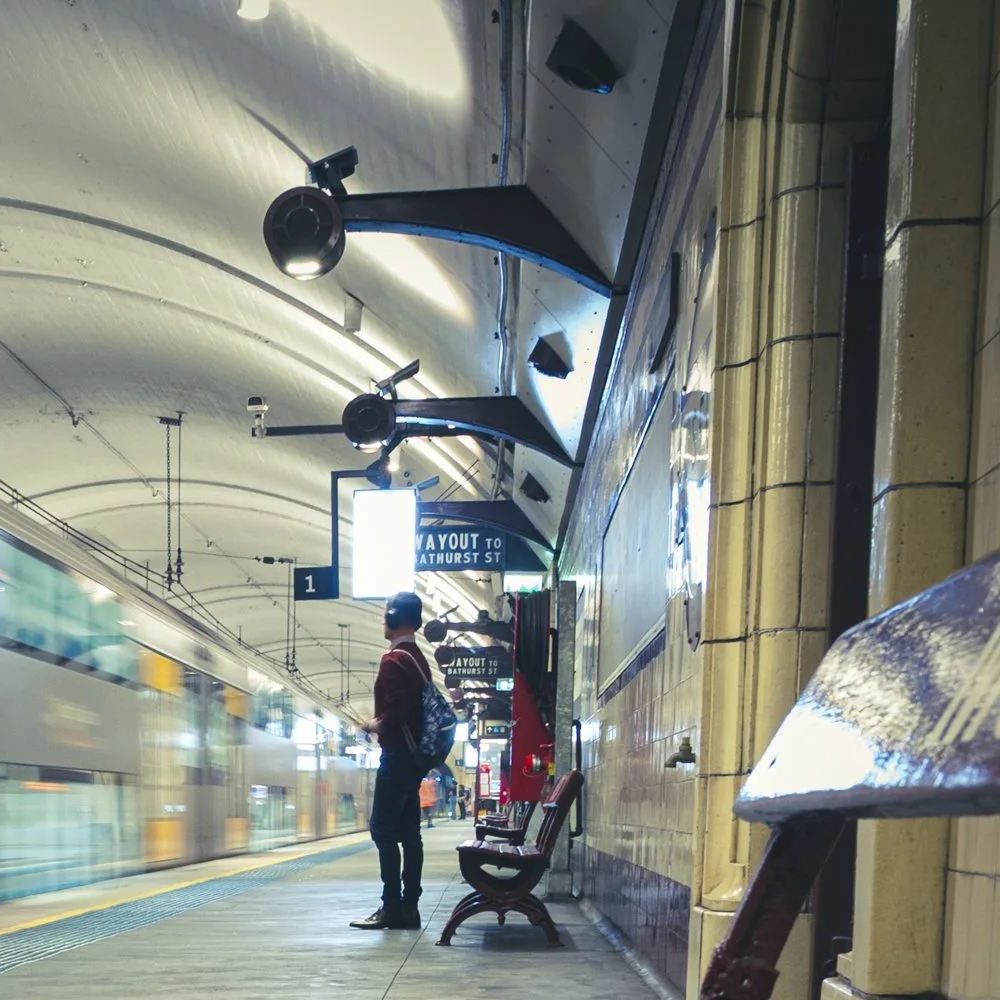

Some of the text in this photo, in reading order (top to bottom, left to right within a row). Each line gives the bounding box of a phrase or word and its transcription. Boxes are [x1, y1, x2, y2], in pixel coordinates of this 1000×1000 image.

[485, 538, 502, 549] TO
[415, 552, 502, 564] ATHURST ST
[304, 574, 316, 593] 1
[447, 667, 498, 675] BATHURST ST
